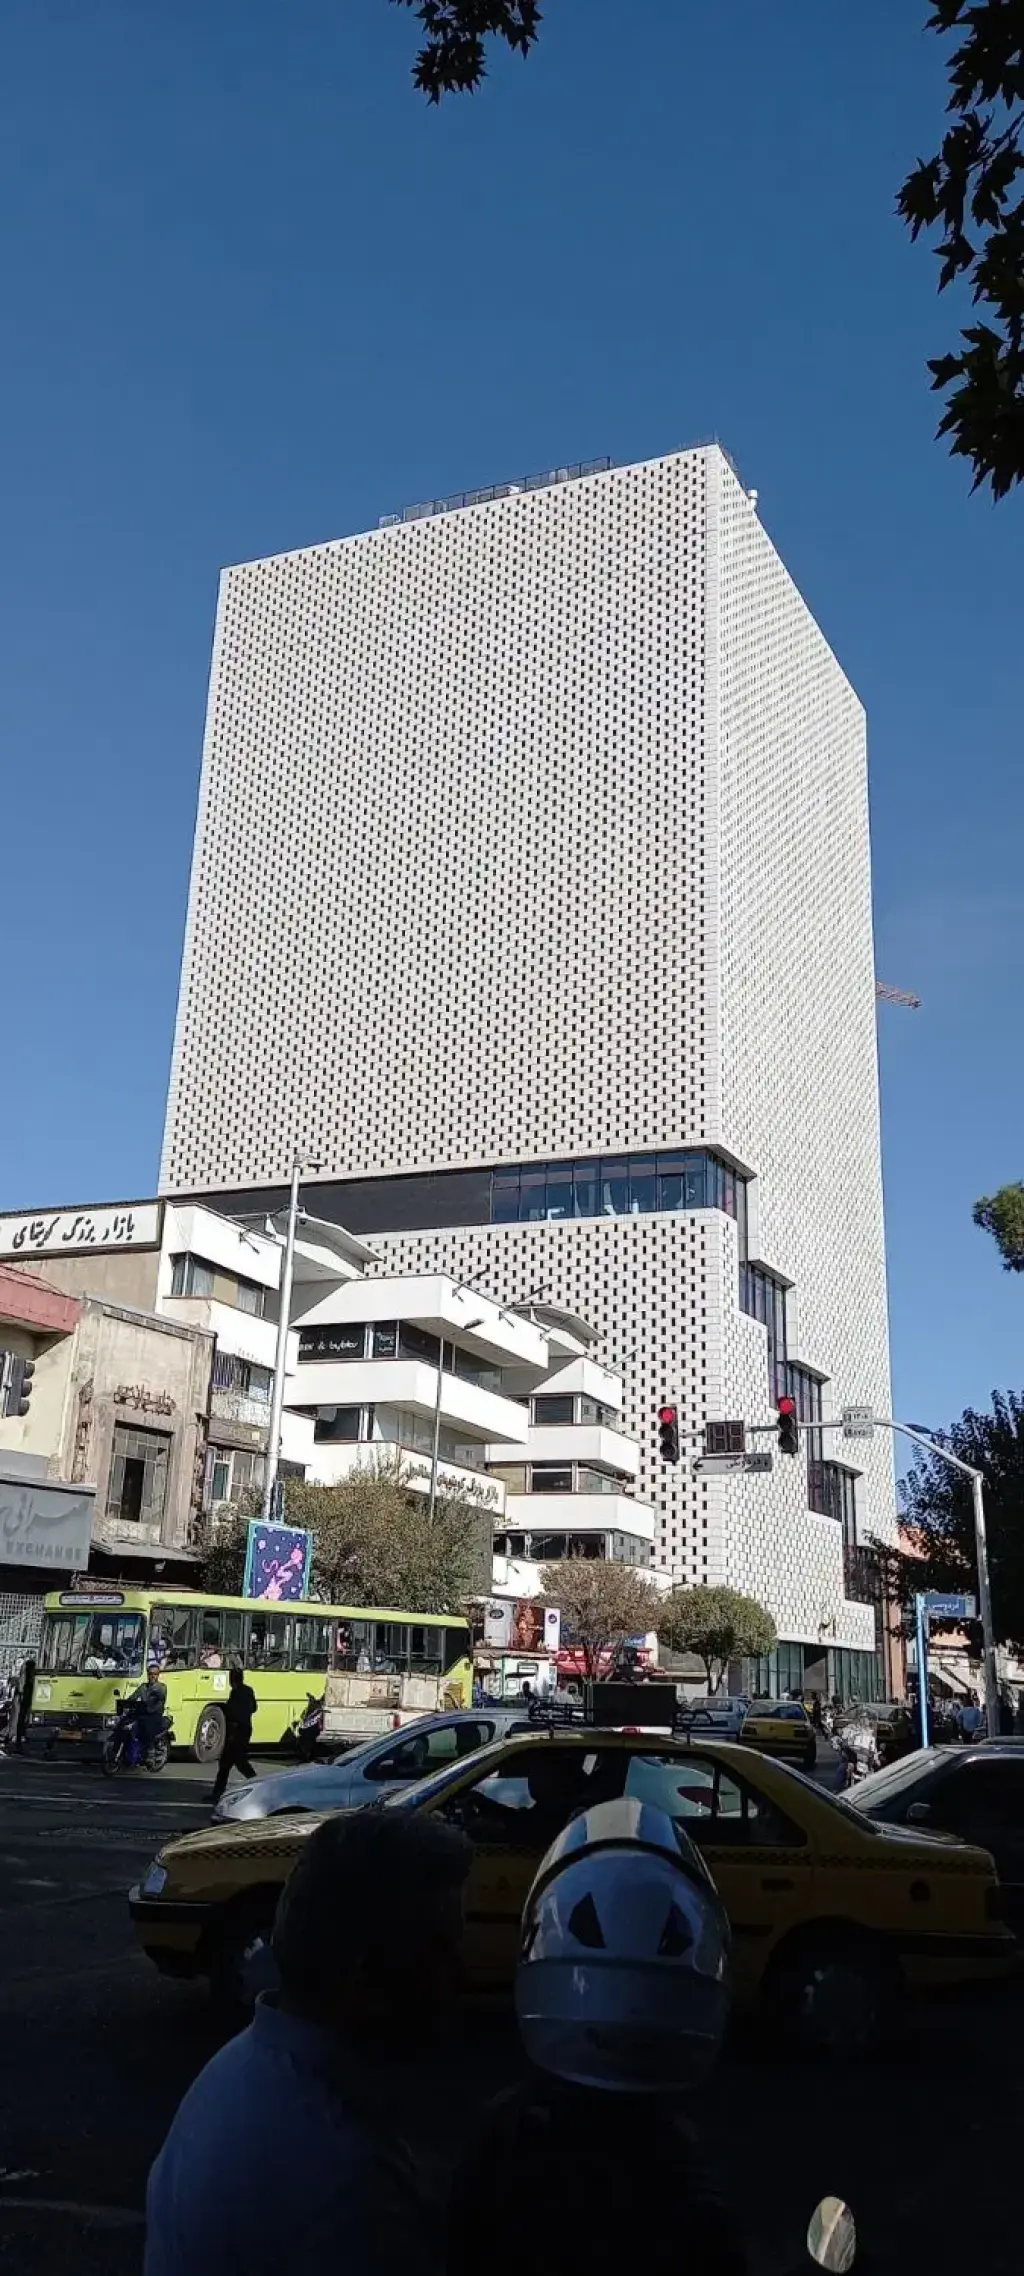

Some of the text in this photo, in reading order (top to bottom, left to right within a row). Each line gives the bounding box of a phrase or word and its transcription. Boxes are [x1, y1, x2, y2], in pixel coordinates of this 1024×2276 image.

[62, 1216, 96, 1243] بزرگ
[102, 1213, 135, 1241] بازار
[6, 1541, 80, 1560] EXCHANGE
